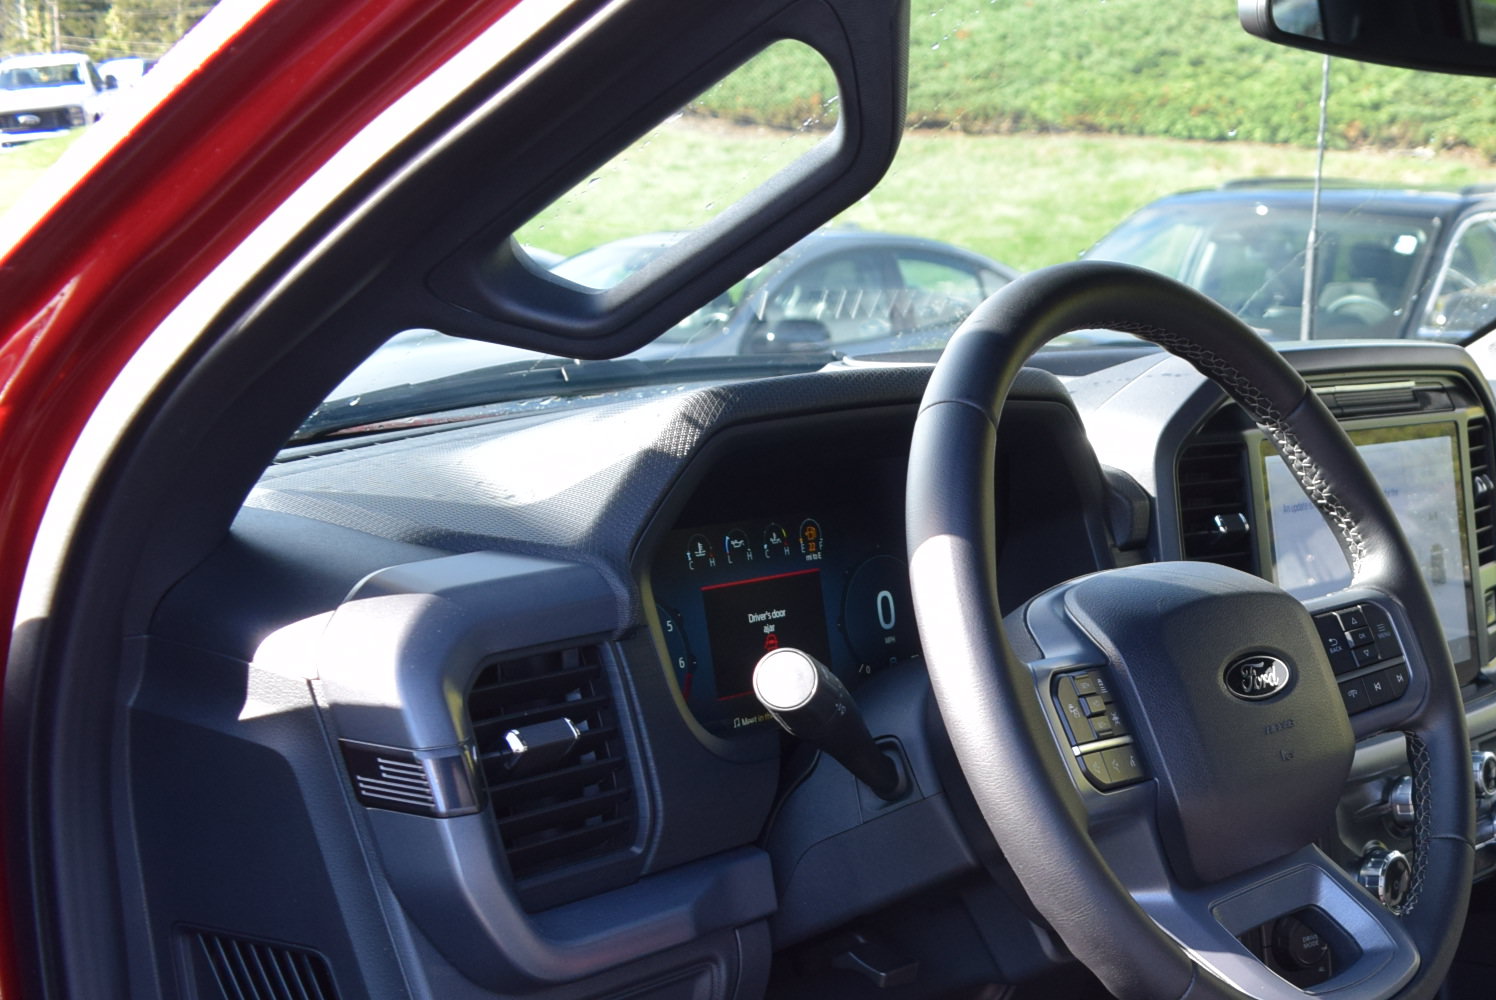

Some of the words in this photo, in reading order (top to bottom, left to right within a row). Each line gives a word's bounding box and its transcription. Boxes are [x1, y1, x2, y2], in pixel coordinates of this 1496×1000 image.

[747, 552, 753, 560] H
[784, 547, 790, 555] H
[709, 558, 716, 567] H
[748, 610, 771, 623] Driver's
[771, 609, 786, 619] door
[877, 590, 896, 630] 0
[666, 620, 673, 632] 5
[763, 624, 776, 634] ajar
[679, 656, 686, 669] 6
[1240, 661, 1280, 692] Ford
